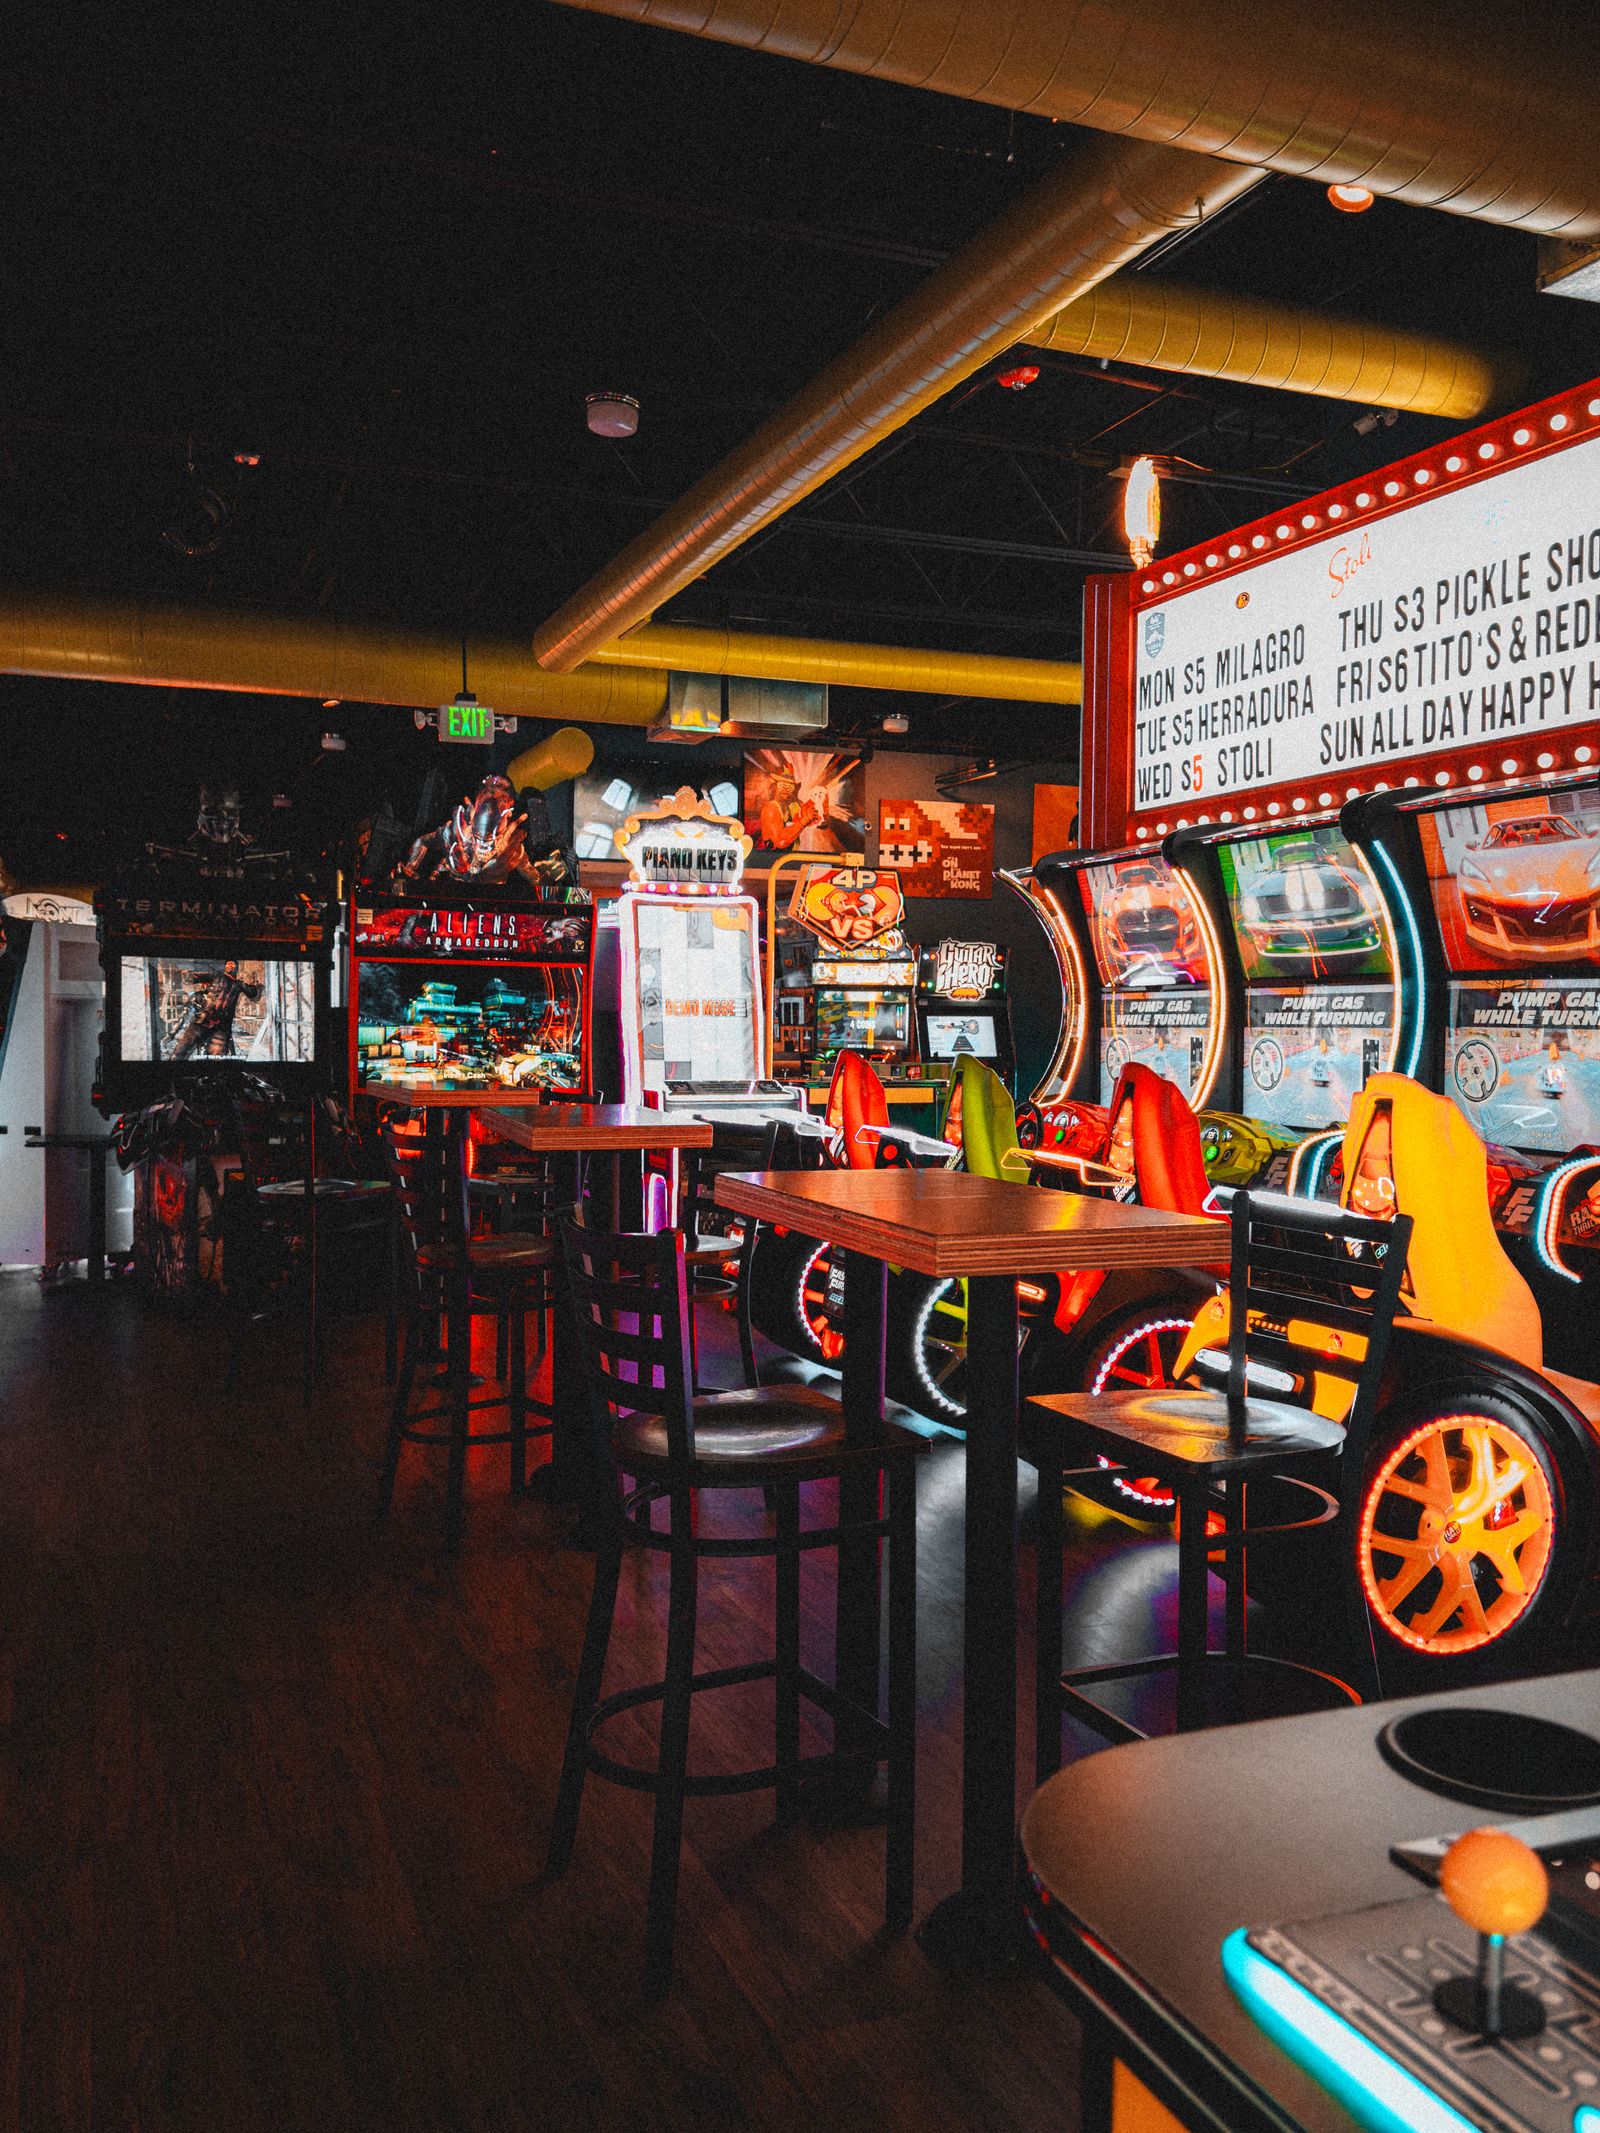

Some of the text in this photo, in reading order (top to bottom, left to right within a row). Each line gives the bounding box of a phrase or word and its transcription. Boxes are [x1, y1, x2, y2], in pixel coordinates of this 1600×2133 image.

[1338, 599, 1383, 652] THU
[1436, 551, 1531, 625] PICKLE
[1139, 666, 1175, 711] MON
[1216, 623, 1305, 688] MILAGRO
[1337, 657, 1372, 708] FRI
[1413, 622, 1501, 688] TITO'S
[1509, 615, 1527, 664] &
[448, 707, 487, 737] EXIT
[1136, 716, 1167, 758] TUE
[1198, 674, 1314, 742] HERRADURA
[1319, 715, 1364, 765] SUN
[1371, 703, 1414, 756] ALL
[1421, 689, 1473, 745] DAY
[1481, 664, 1576, 733] HAPPY
[1138, 762, 1172, 803] WED
[1218, 737, 1272, 787] STOLI
[642, 846, 738, 871] PIANO KEYS
[942, 856, 958, 868] ON
[832, 869, 877, 890] 4P
[943, 869, 981, 881] PLANET
[950, 880, 980, 891] KONG
[116, 899, 322, 920] TERMINATOR
[430, 912, 517, 937] ALIENS
[830, 916, 875, 940] VS
[425, 936, 519, 950] ARMAGEDDON
[1129, 999, 1192, 1013] PUMP GAS
[1281, 995, 1365, 1011] PUMP GAS
[1497, 991, 1561, 1008] PUMP
[1116, 1013, 1208, 1026] WHILE TURNING
[1264, 1011, 1386, 1026] WHILE TURNING
[1473, 1009, 1600, 1026] WHILE TURN
